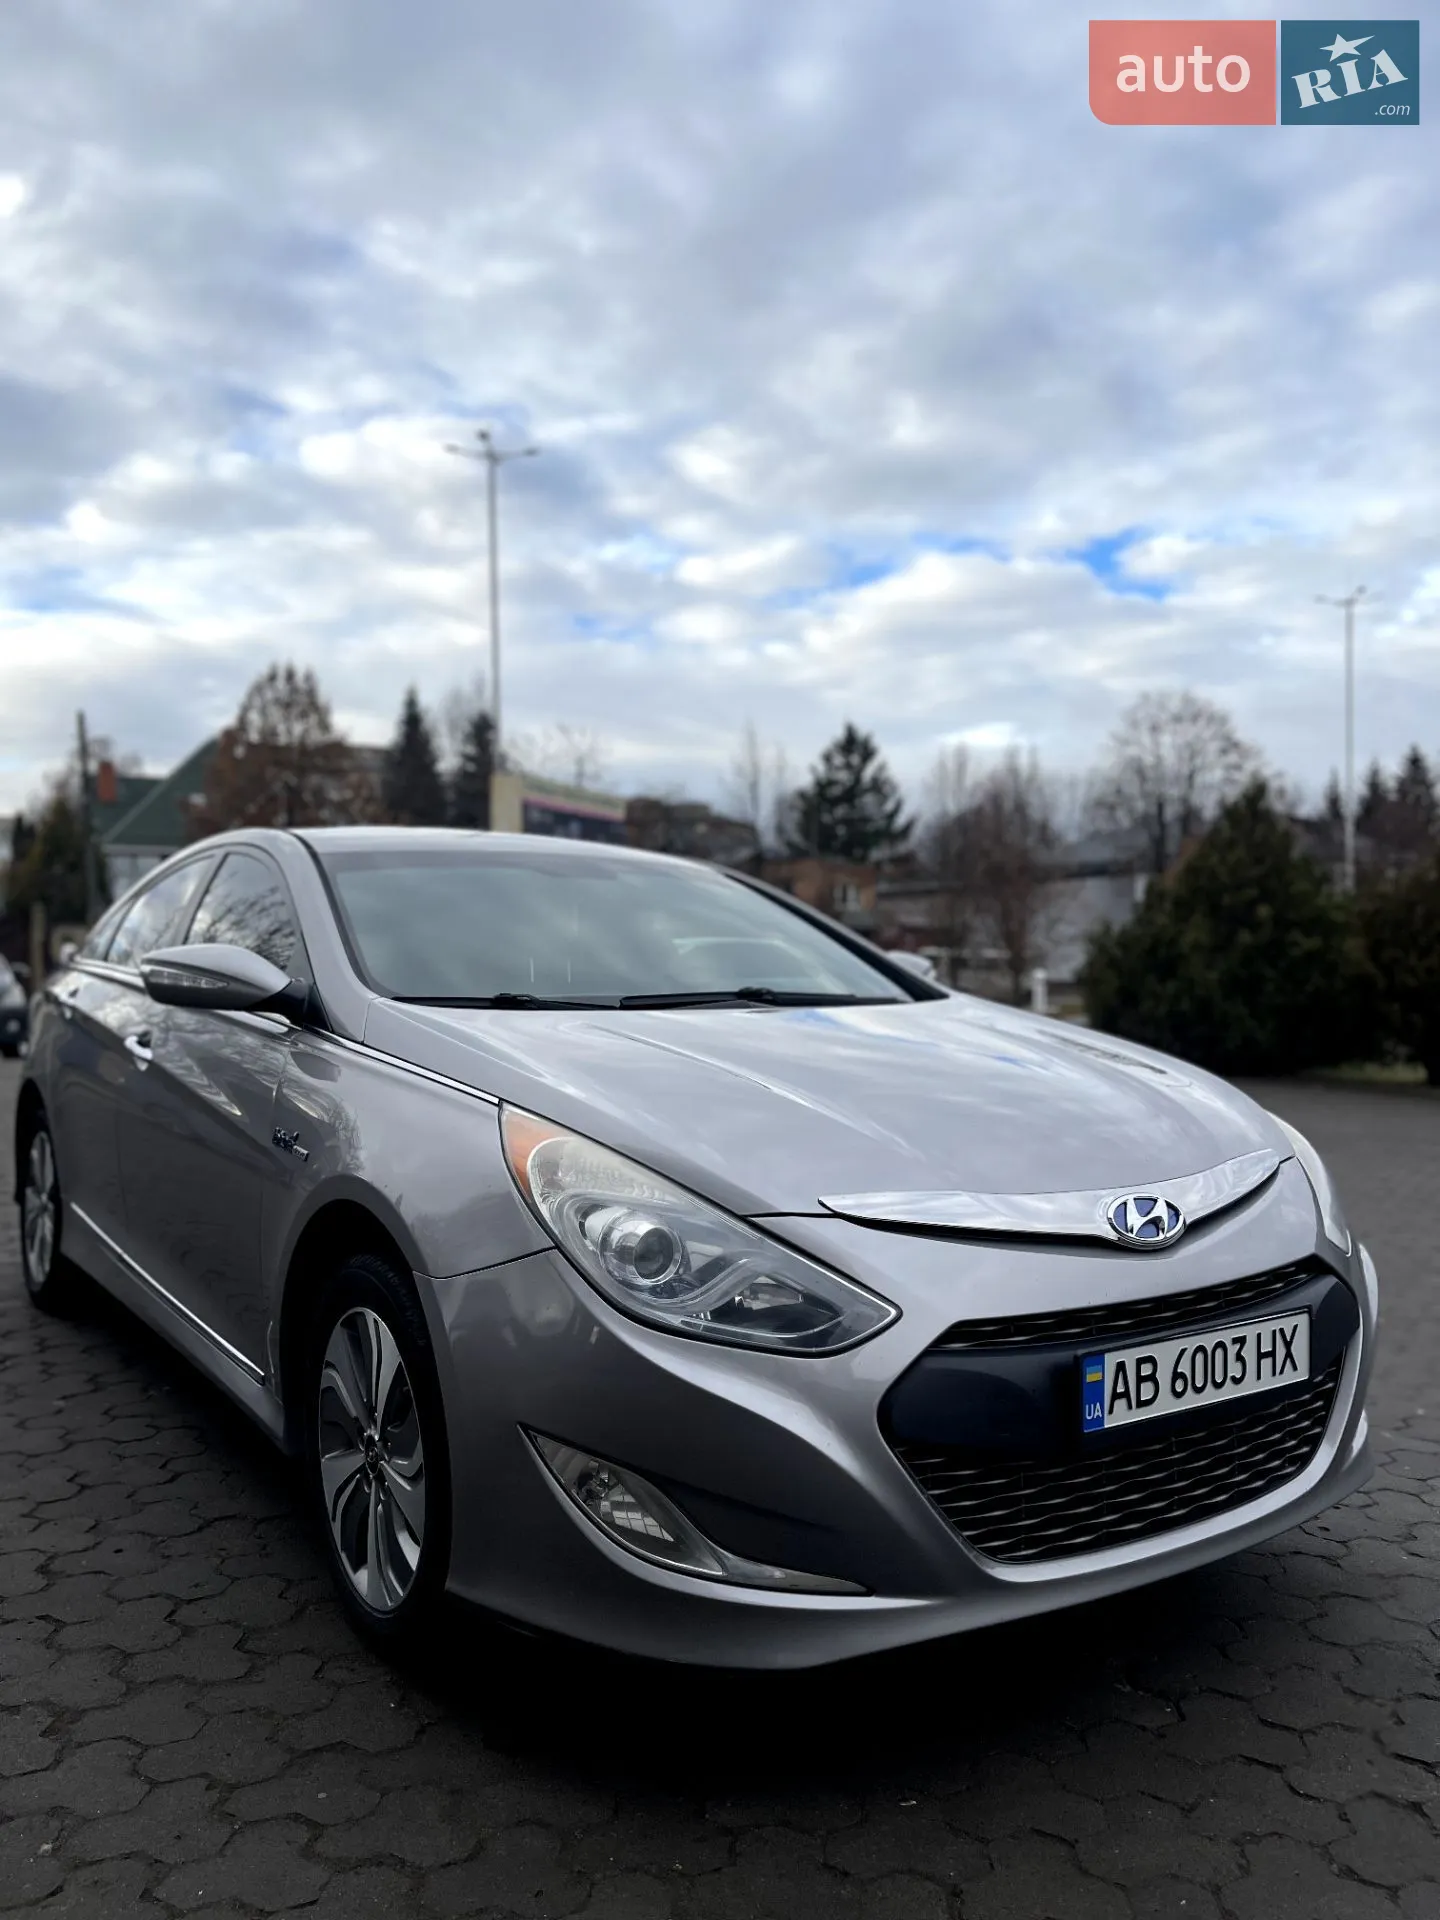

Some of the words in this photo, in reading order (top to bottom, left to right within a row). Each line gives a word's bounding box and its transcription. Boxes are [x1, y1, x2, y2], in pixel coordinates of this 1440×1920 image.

[1107, 1354, 1160, 1415] AB
[1171, 1334, 1248, 1399] 6003
[1256, 1323, 1299, 1381] HX
[1085, 1402, 1102, 1420] UA
